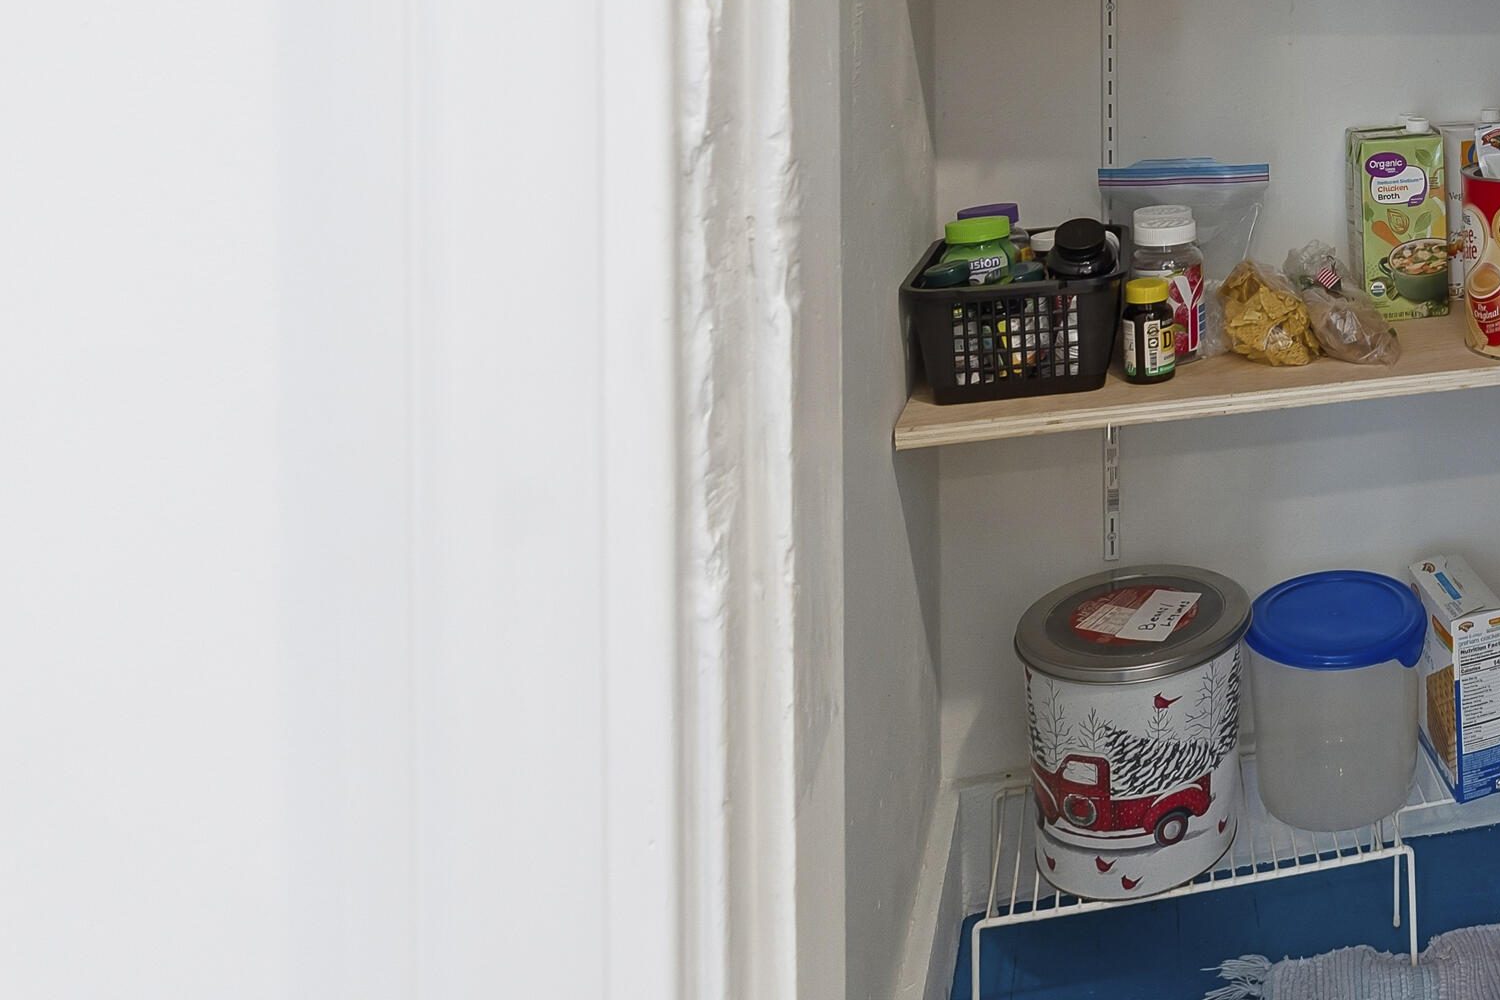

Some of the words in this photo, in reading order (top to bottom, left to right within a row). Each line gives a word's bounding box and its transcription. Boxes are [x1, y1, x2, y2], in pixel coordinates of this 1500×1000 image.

[1369, 159, 1403, 170] Organic
[1377, 185, 1409, 193] Chicken
[1377, 193, 1400, 201] Broth
[1460, 645, 1487, 656] Nutrition
